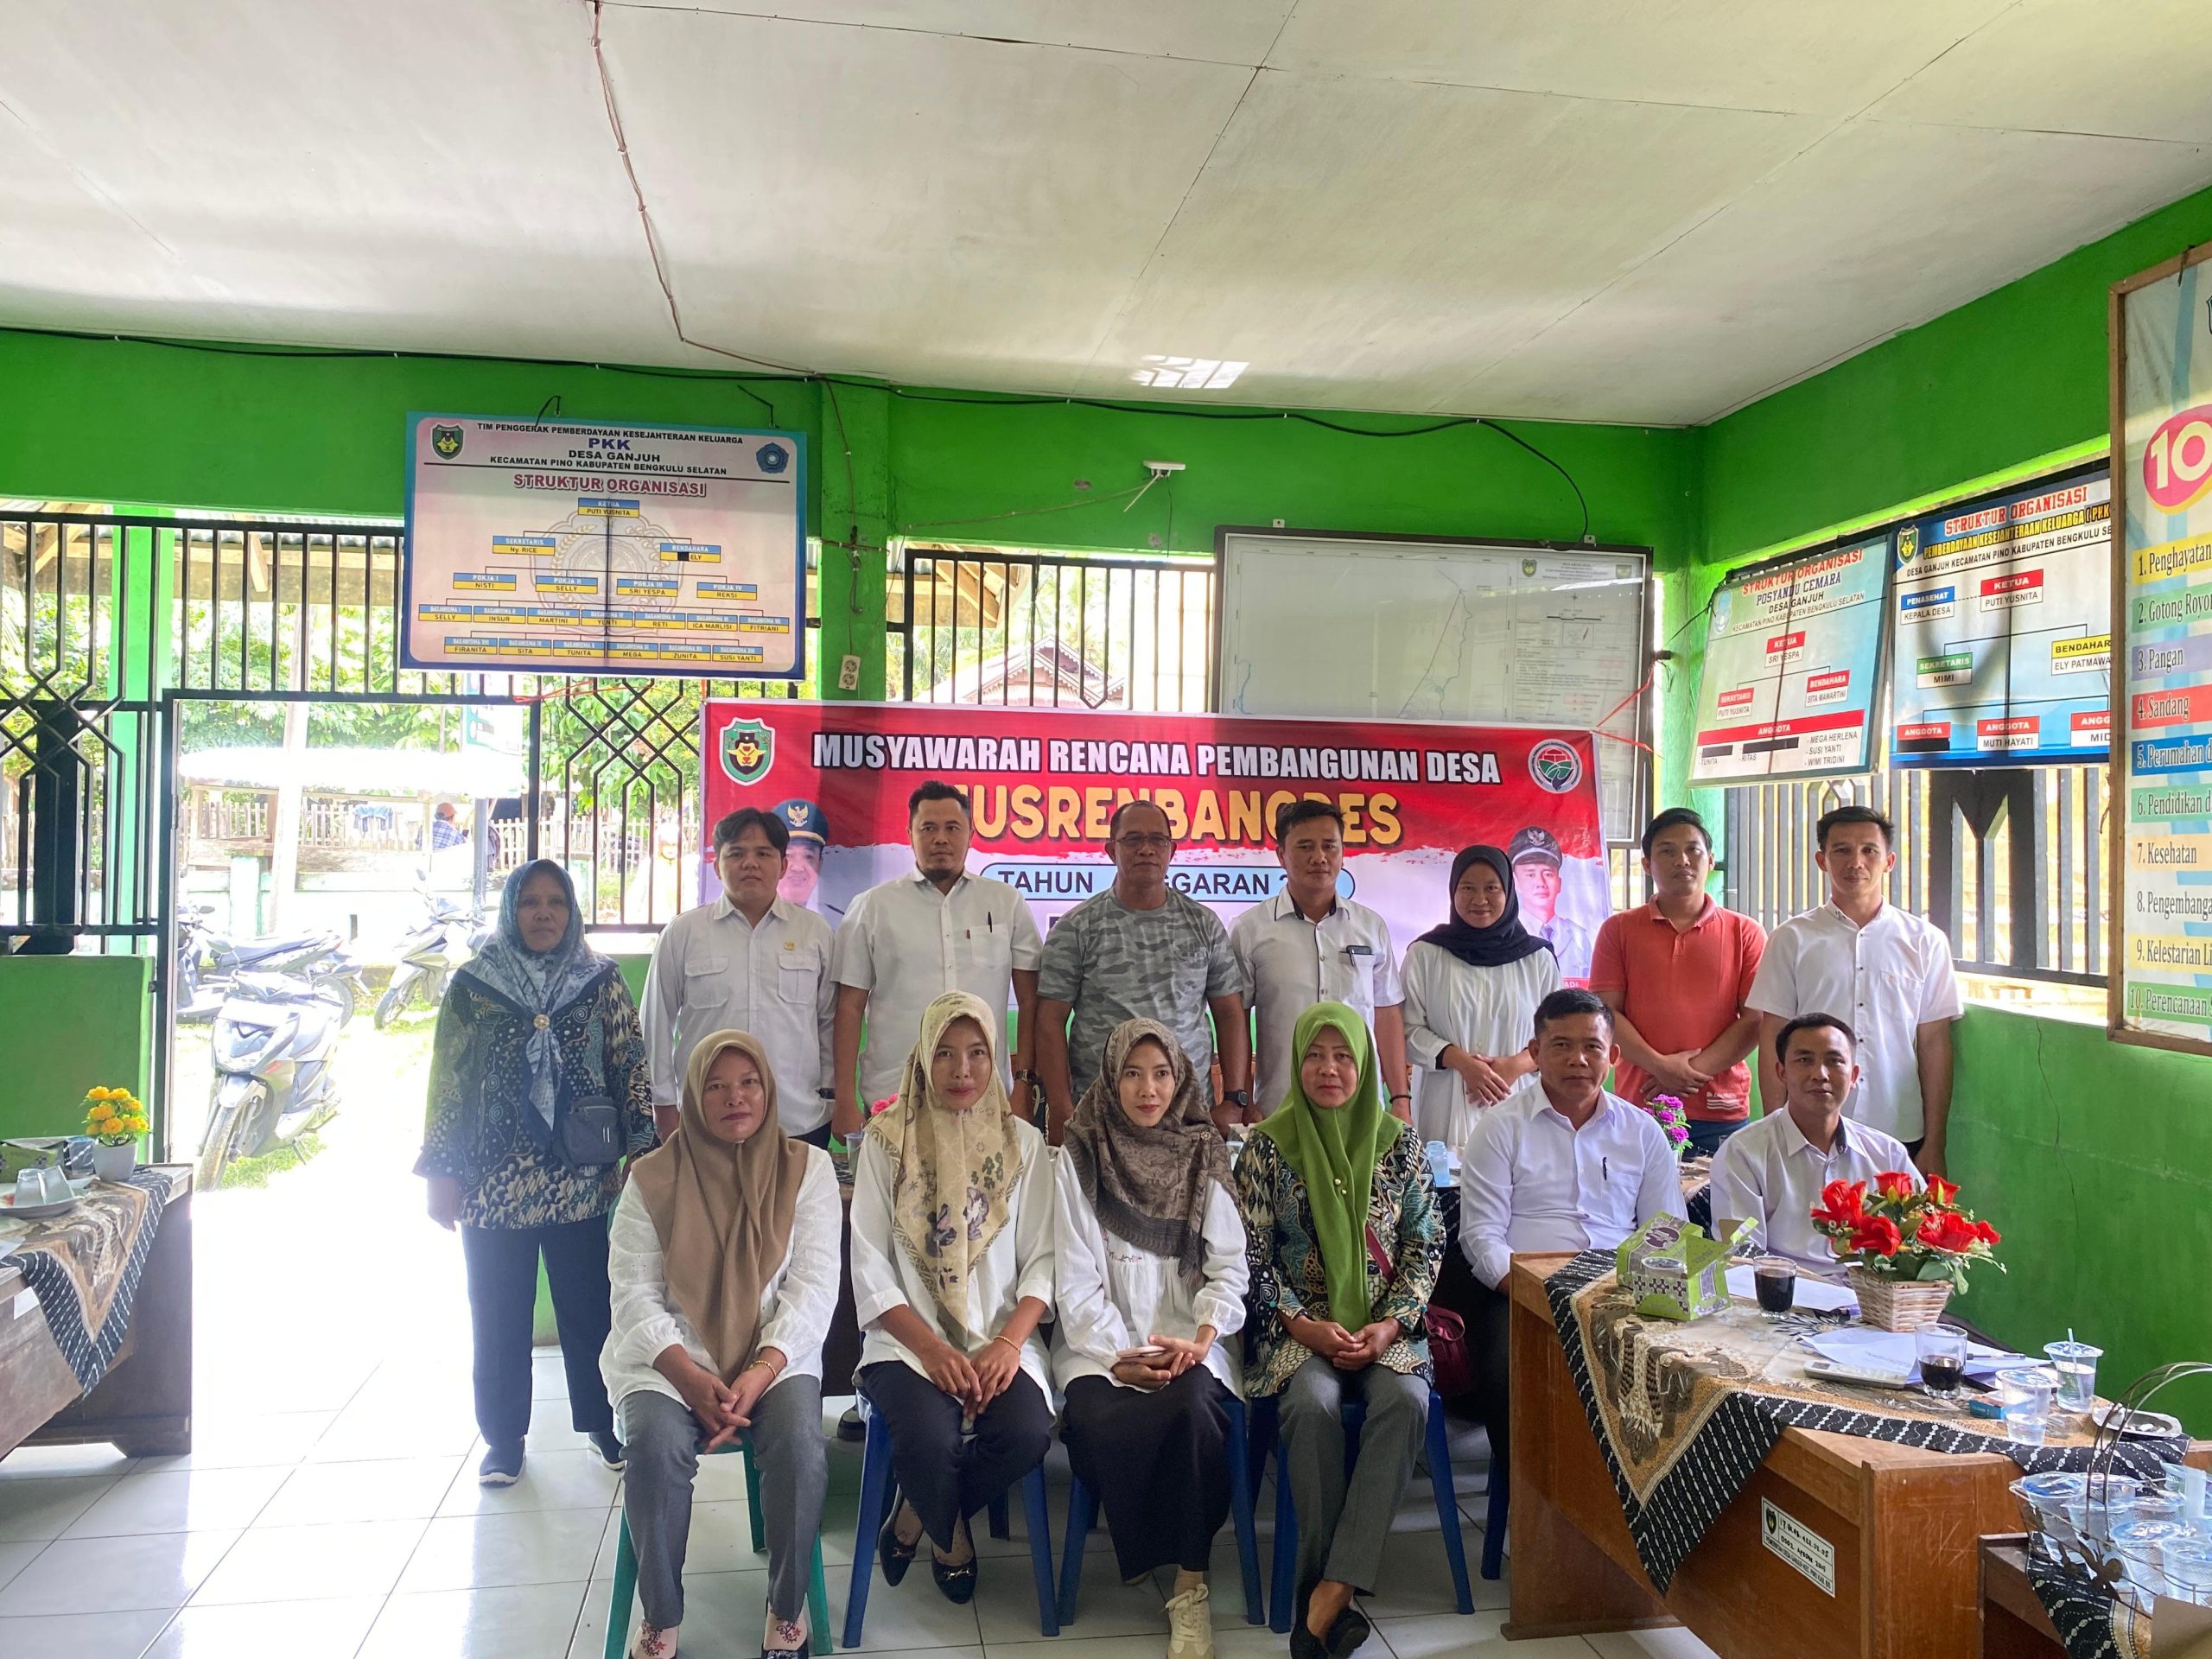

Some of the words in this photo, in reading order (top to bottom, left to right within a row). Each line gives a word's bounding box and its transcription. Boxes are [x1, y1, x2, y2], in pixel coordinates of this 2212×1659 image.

[476, 423, 493, 431] TIM
[495, 424, 550, 434] PENGGERAK
[551, 427, 621, 437] PEMBERDAYAAN
[622, 430, 696, 442] KESEJAHTERAAN
[698, 435, 744, 445] KELUARGA
[588, 437, 632, 451] PKK
[490, 455, 548, 466] KECAMATAN
[550, 459, 573, 467] PINO
[575, 460, 631, 471] KABUPATEN
[633, 463, 683, 474] BENGKULU
[686, 467, 728, 475] SELATAN
[569, 449, 603, 460] DESA
[607, 452, 661, 463] GANJUH
[2151, 421, 2212, 489] 10
[513, 474, 604, 492] STRUKTUR
[607, 479, 707, 497] ORGANISASI
[1946, 507, 2006, 536] STRUKTUR
[2010, 485, 2088, 521] ORGANISASI
[1923, 535, 1979, 560] PEMBERDAYAAN
[1978, 519, 2041, 548] KESEJAHTERAAN
[2041, 509, 2085, 534] KELUARGA
[1906, 565, 1923, 577] DESA
[1923, 561, 1949, 574] GANJUH
[1951, 551, 1991, 568] KECAMATAN
[1993, 547, 2010, 558] PINO
[2011, 537, 2055, 556] KABUPATEN
[2056, 528, 2100, 545] BENGKULU
[2139, 554, 2147, 576] 1.
[2149, 543, 2212, 575] Penghayatan
[1742, 570, 1795, 595] STRUKTUR
[1797, 549, 1864, 579] ORGANISASI
[1756, 583, 1801, 607] POSYANDU
[1802, 572, 1841, 594] CEMARA
[1993, 579, 2030, 590] KETUA
[1769, 601, 1789, 613] DESA
[1790, 592, 1825, 607] GANJUH
[1838, 592, 1865, 606] SELATAN
[1906, 591, 1949, 606] PENASEHAT
[1986, 597, 2003, 607] PUTI
[2004, 591, 2038, 604] YUSNITA
[1904, 609, 1930, 620] KEPALA
[1932, 607, 1951, 616] DESA
[2139, 602, 2146, 624] 2.
[2149, 599, 2183, 623] Gotong
[1774, 637, 1797, 648] KEUA
[1768, 655, 1779, 664] SRI
[1919, 657, 1970, 671] SEKRETARIS
[2055, 660, 2069, 671] ELY
[2139, 650, 2146, 671] 3.
[2149, 648, 2183, 673] Pangan
[1933, 674, 1955, 683] MIMI
[1807, 694, 1818, 703] SITA
[2138, 696, 2146, 719] 4.
[2149, 694, 2189, 721] Sandang
[1810, 734, 1827, 744] MEGA
[1828, 730, 1858, 742] HERLENA
[1904, 727, 1943, 737] ANGGOTA
[1986, 721, 2031, 732] ANGGOTA
[1808, 746, 1823, 755] SUSI
[1824, 744, 1842, 753] YANTI
[1983, 738, 2003, 747] MUTI
[2004, 737, 2033, 747] HAYATI
[813, 734, 1041, 772] MUSYAWARAH
[1049, 740, 1191, 776] RENCANA
[1197, 745, 1419, 782] PEMBANGUNAN
[1426, 752, 1501, 784] DESA
[2147, 740, 2203, 767] Perumahan
[954, 784, 1402, 844] USREBANES
[2138, 794, 2145, 816] 6.
[2148, 791, 2202, 816] Pendidikan
[2137, 842, 2145, 864] 7.
[2147, 841, 2197, 864] Kesehatan
[997, 870, 1094, 893] TAHUN
[2137, 890, 2145, 912] 8.
[2137, 939, 2145, 962] 9.
[2146, 939, 2201, 966] Kelestarian
[2146, 988, 2207, 1017] Perencanaan
